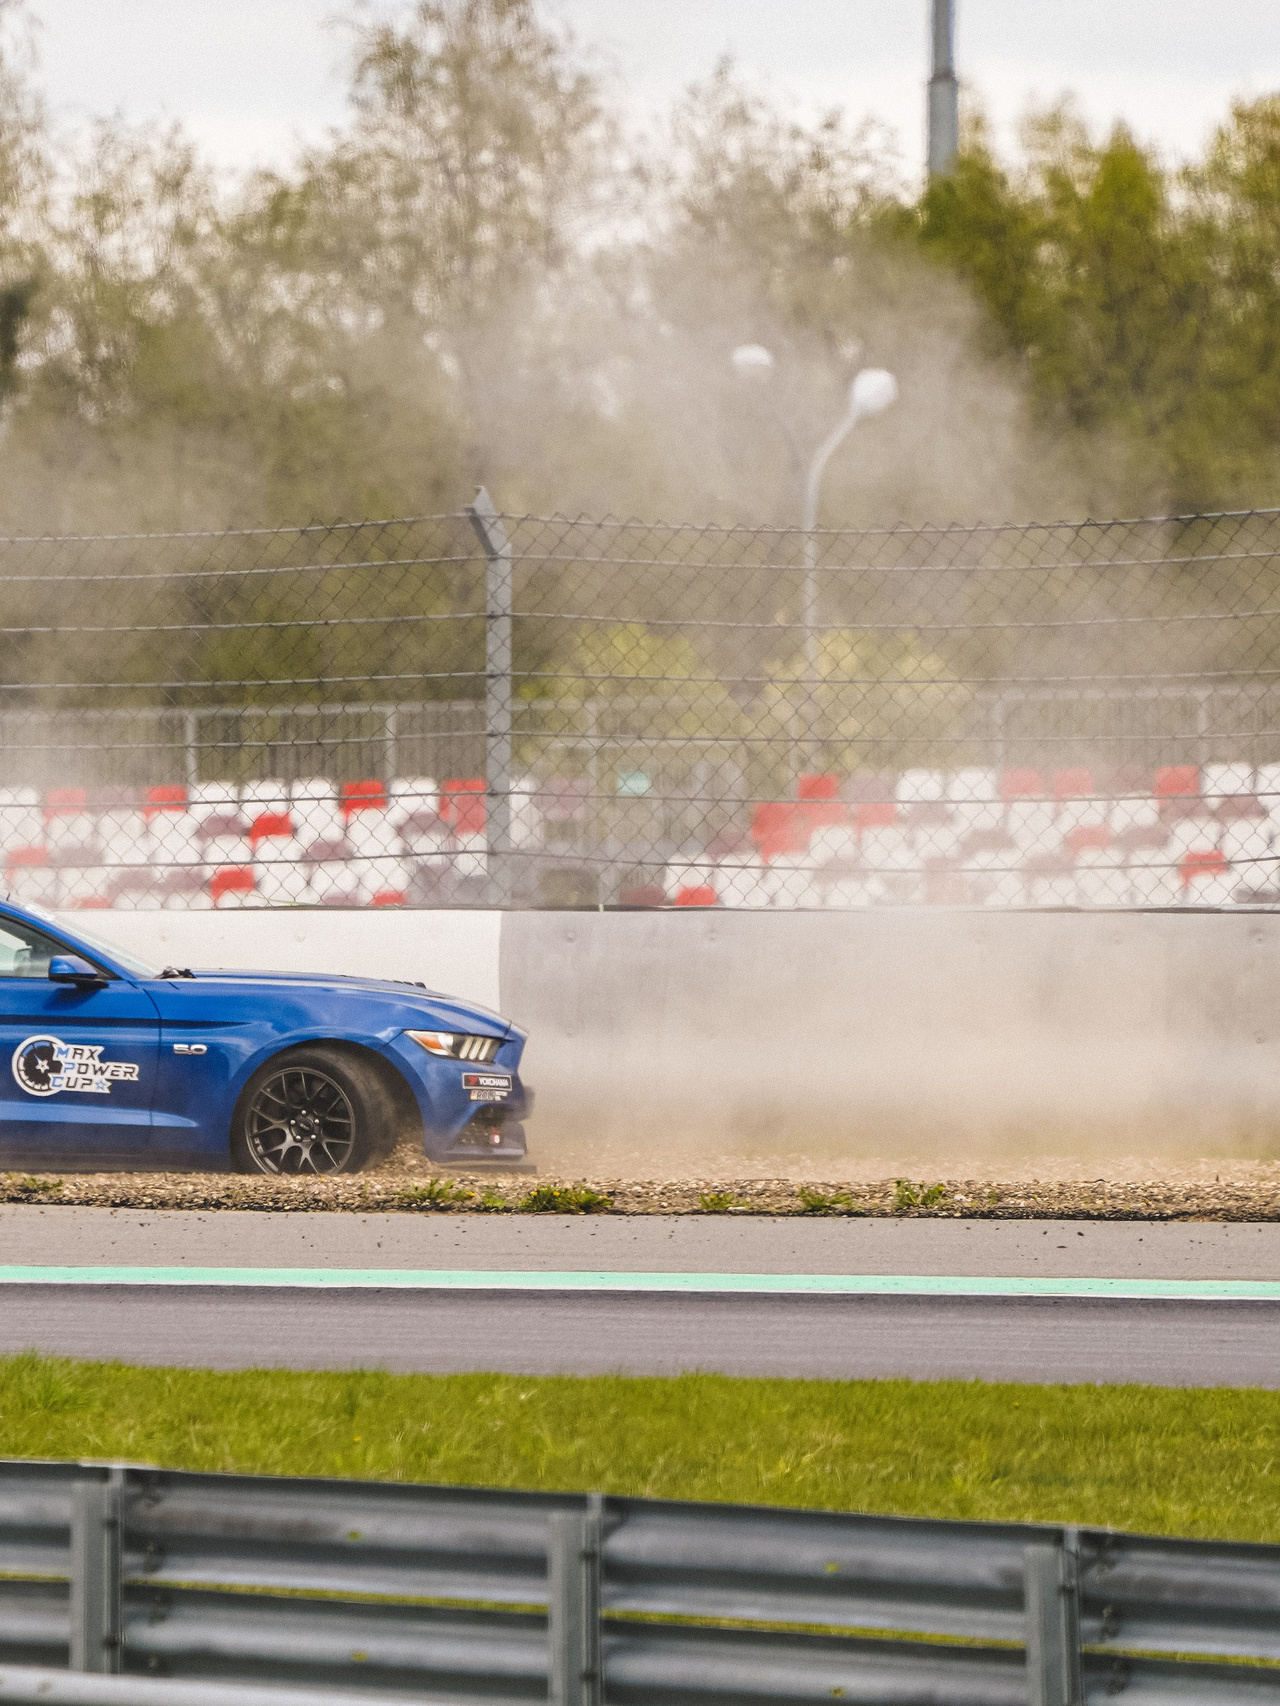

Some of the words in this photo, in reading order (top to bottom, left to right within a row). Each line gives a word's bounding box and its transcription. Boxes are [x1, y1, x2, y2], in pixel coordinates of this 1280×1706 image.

[56, 1047, 98, 1061] MAX
[63, 1062, 136, 1078] POWER
[51, 1076, 93, 1089] CUP
[478, 1076, 509, 1087] YOKOHAMA
